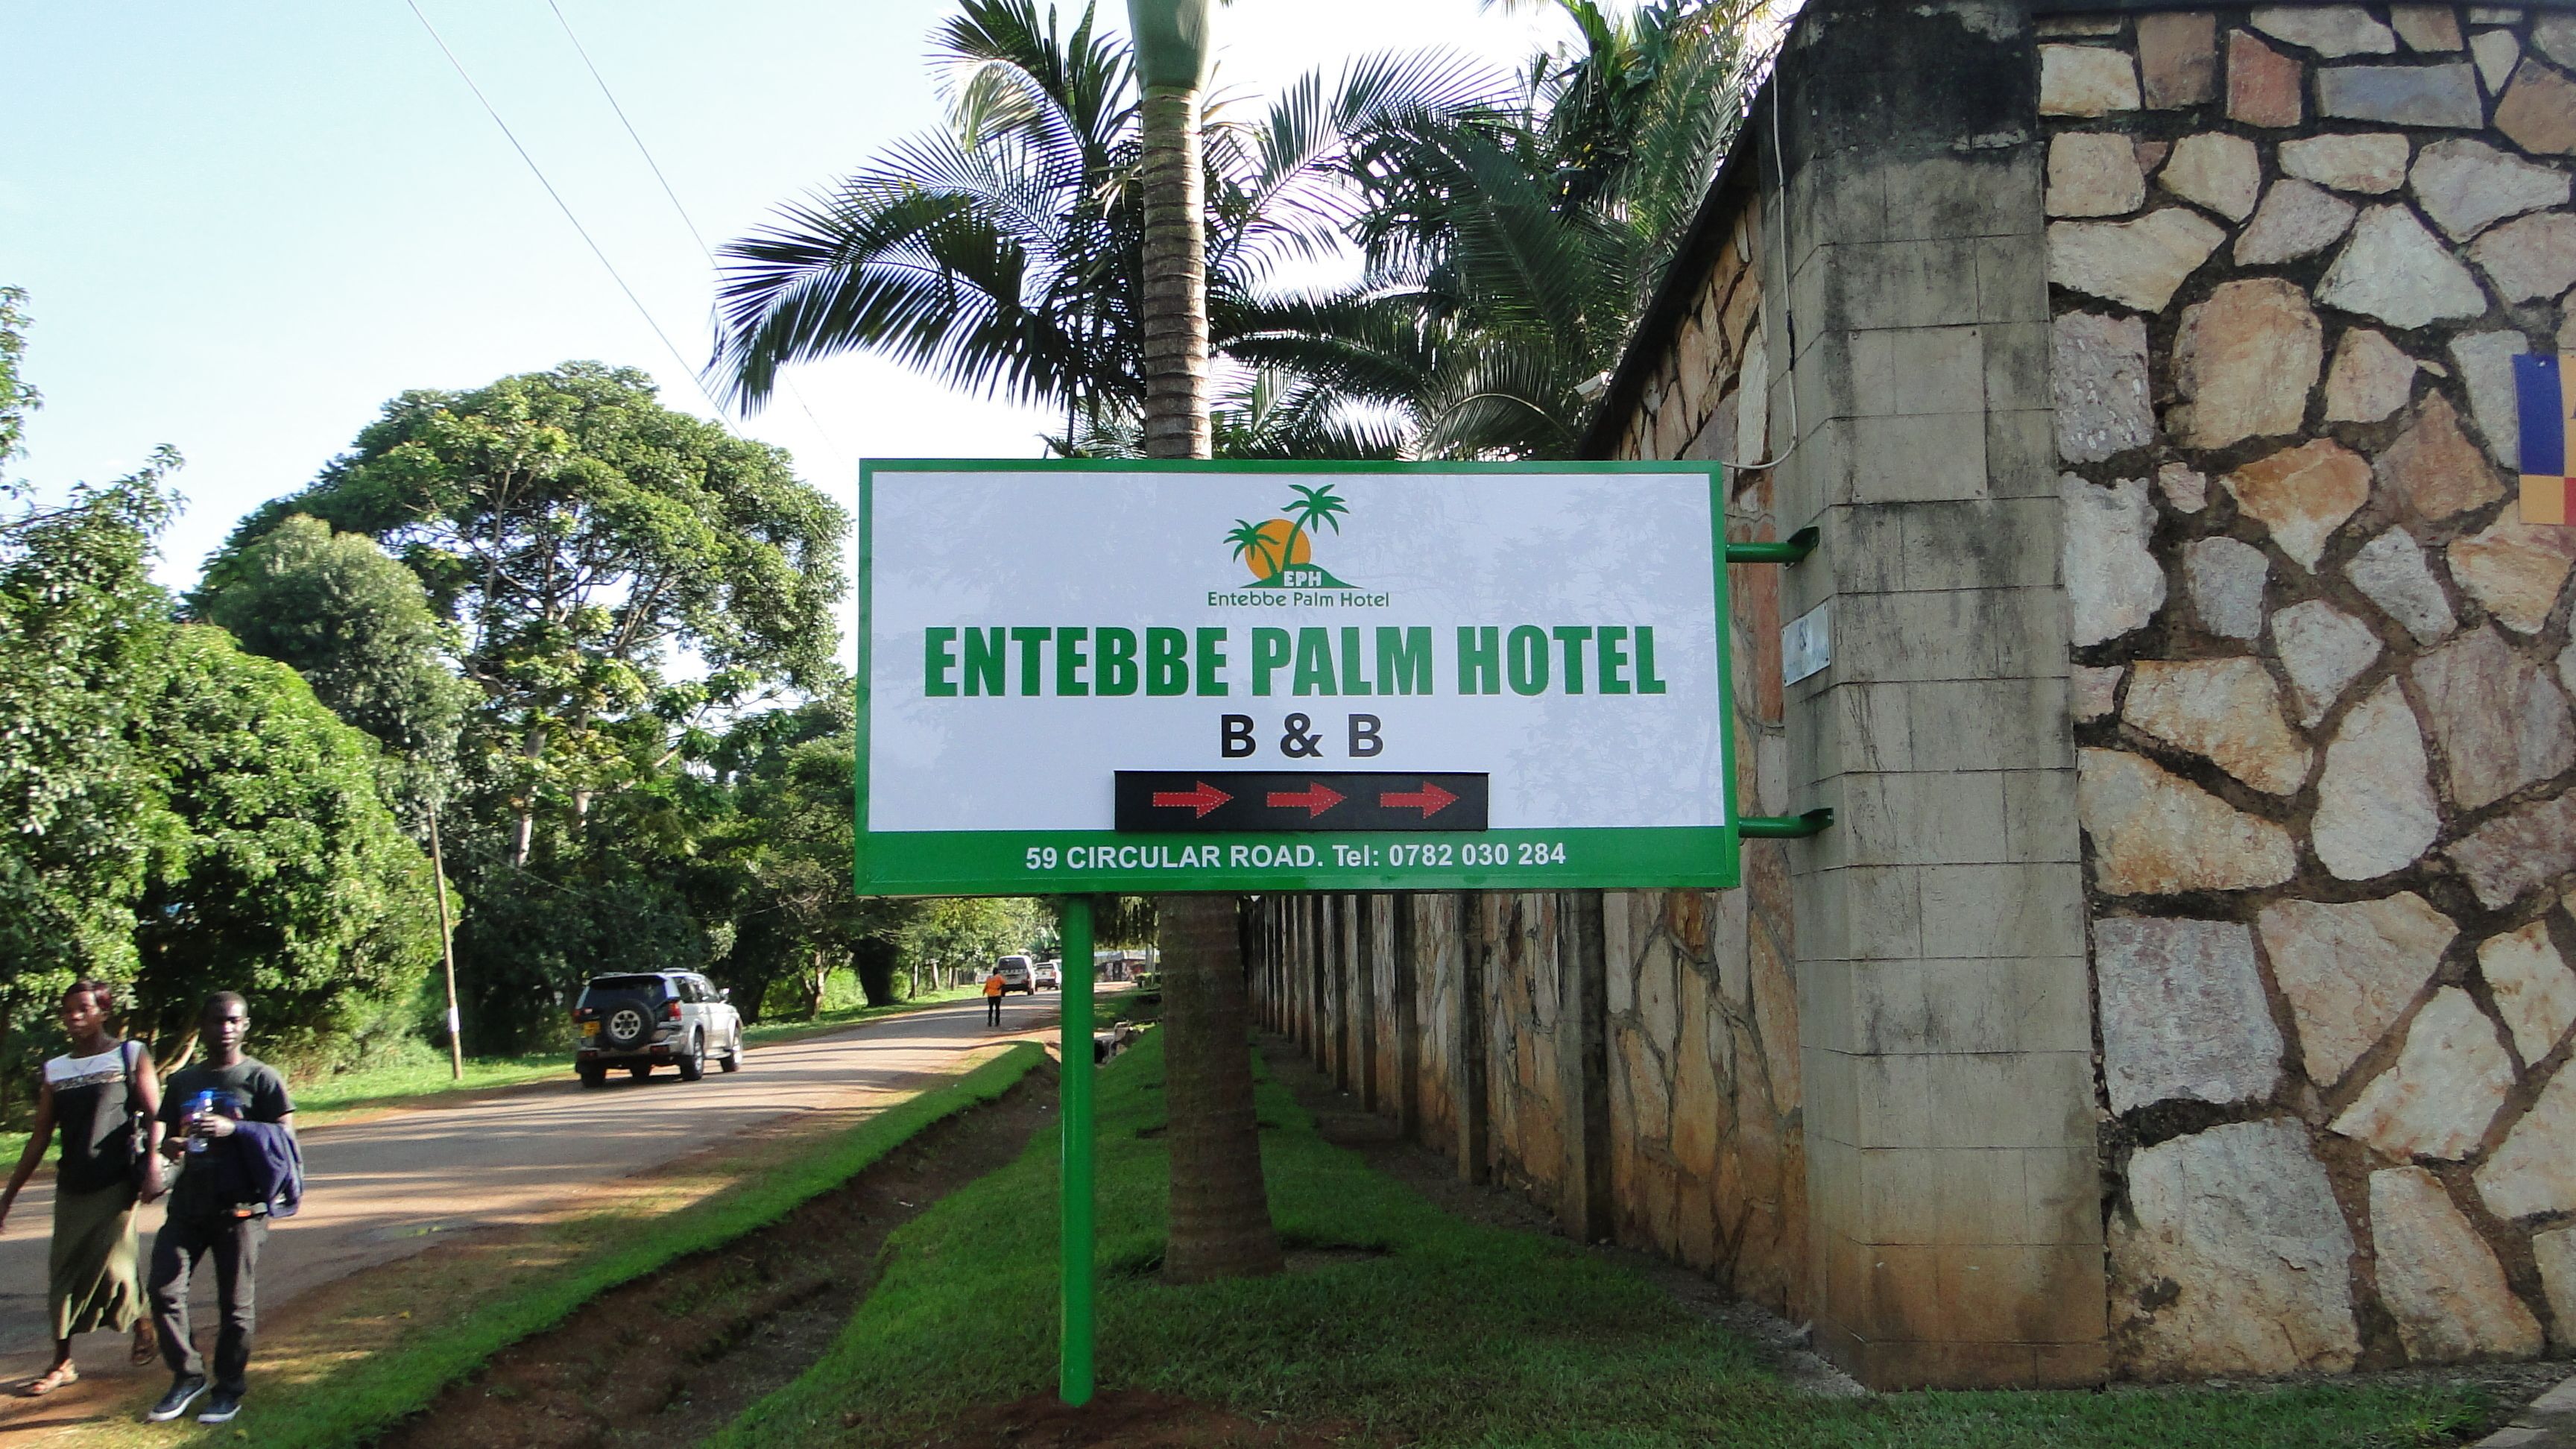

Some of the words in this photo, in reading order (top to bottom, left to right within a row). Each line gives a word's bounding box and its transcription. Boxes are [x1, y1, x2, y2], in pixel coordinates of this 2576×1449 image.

[1284, 571, 1322, 587] EPH
[1208, 591, 1287, 607] Entebbe
[1294, 591, 1333, 607] Palm
[1341, 592, 1389, 607] Hotel
[925, 627, 1228, 697] ENTEBBE
[1252, 627, 1433, 696] PALM
[1457, 625, 1666, 695] HOTEL
[1221, 714, 1256, 758] B
[1280, 713, 1323, 758] &
[1348, 713, 1383, 757] B
[1026, 847, 1057, 869] 59
[1067, 846, 1220, 869] CIRCULAR
[1231, 845, 1323, 868] ROAD.
[1333, 845, 1379, 866] Tel:
[1389, 845, 1453, 866] 0782
[1462, 844, 1509, 866] 030
[1518, 842, 1566, 865] 284
